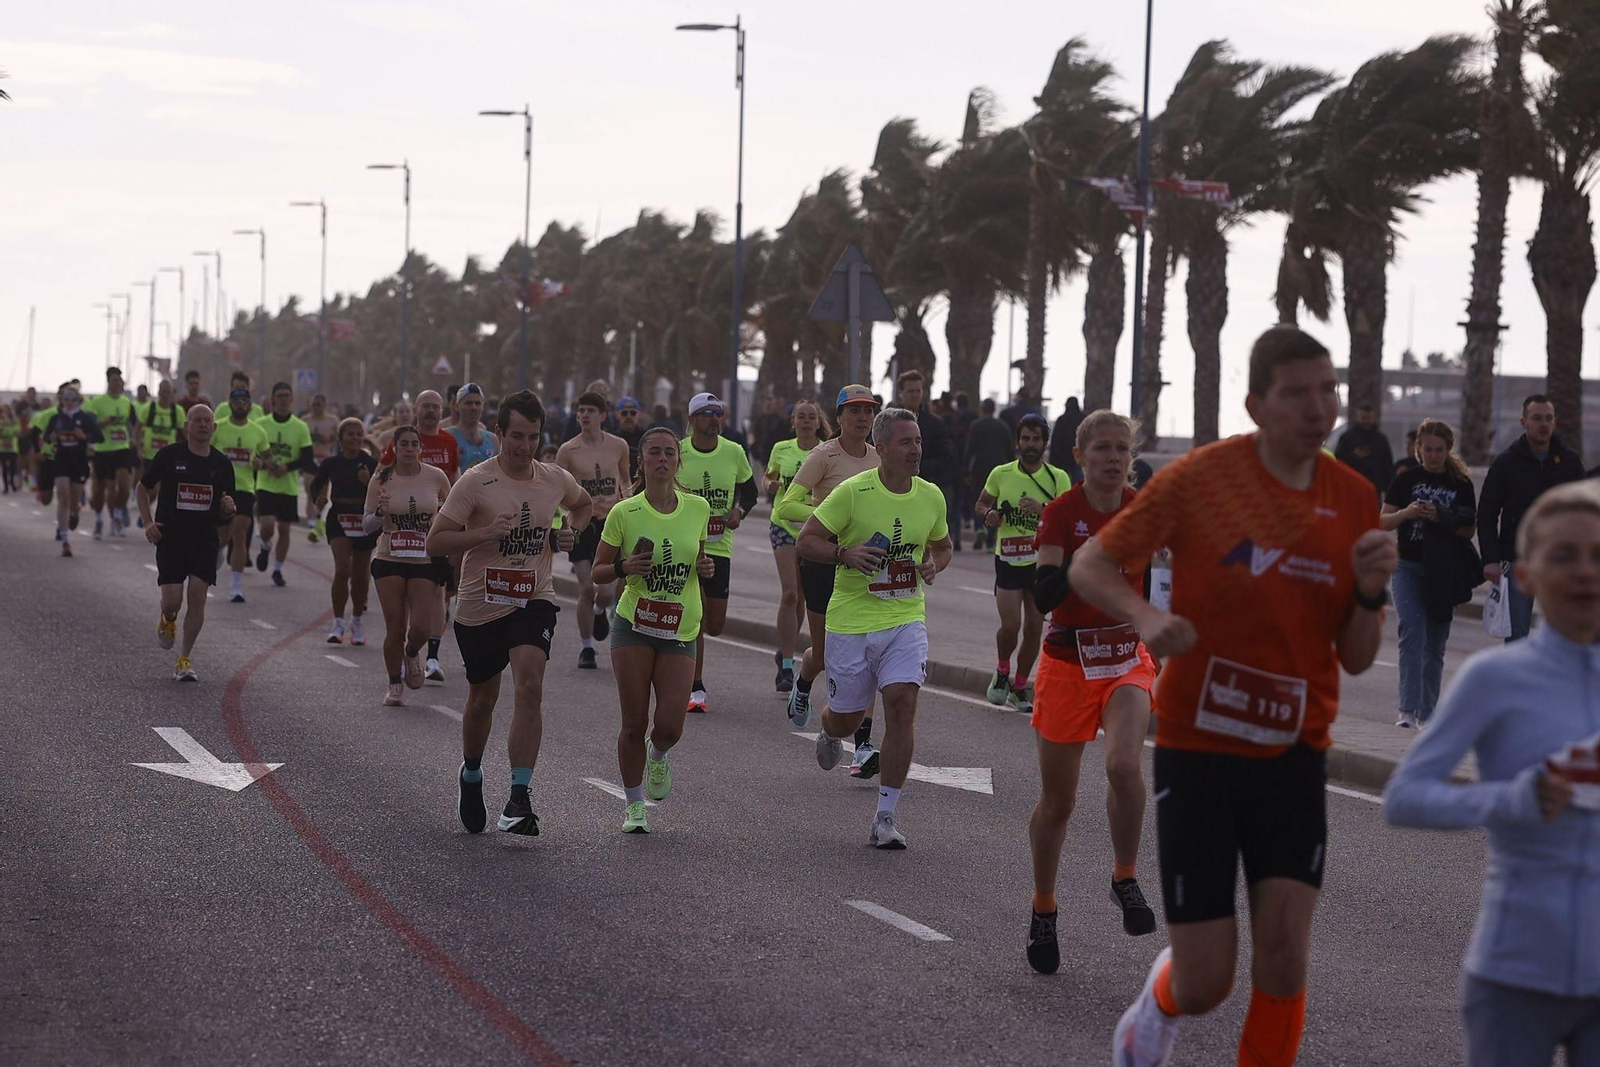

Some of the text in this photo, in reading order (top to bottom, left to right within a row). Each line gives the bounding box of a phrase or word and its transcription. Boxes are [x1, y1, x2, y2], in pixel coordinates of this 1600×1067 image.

[406, 539, 425, 547] 1323
[499, 539, 528, 558] RUN
[895, 572, 913, 584] 487
[512, 582, 533, 593] 489
[660, 614, 679, 625] 488
[1116, 640, 1137, 657] 309
[1257, 697, 1293, 722] 119
